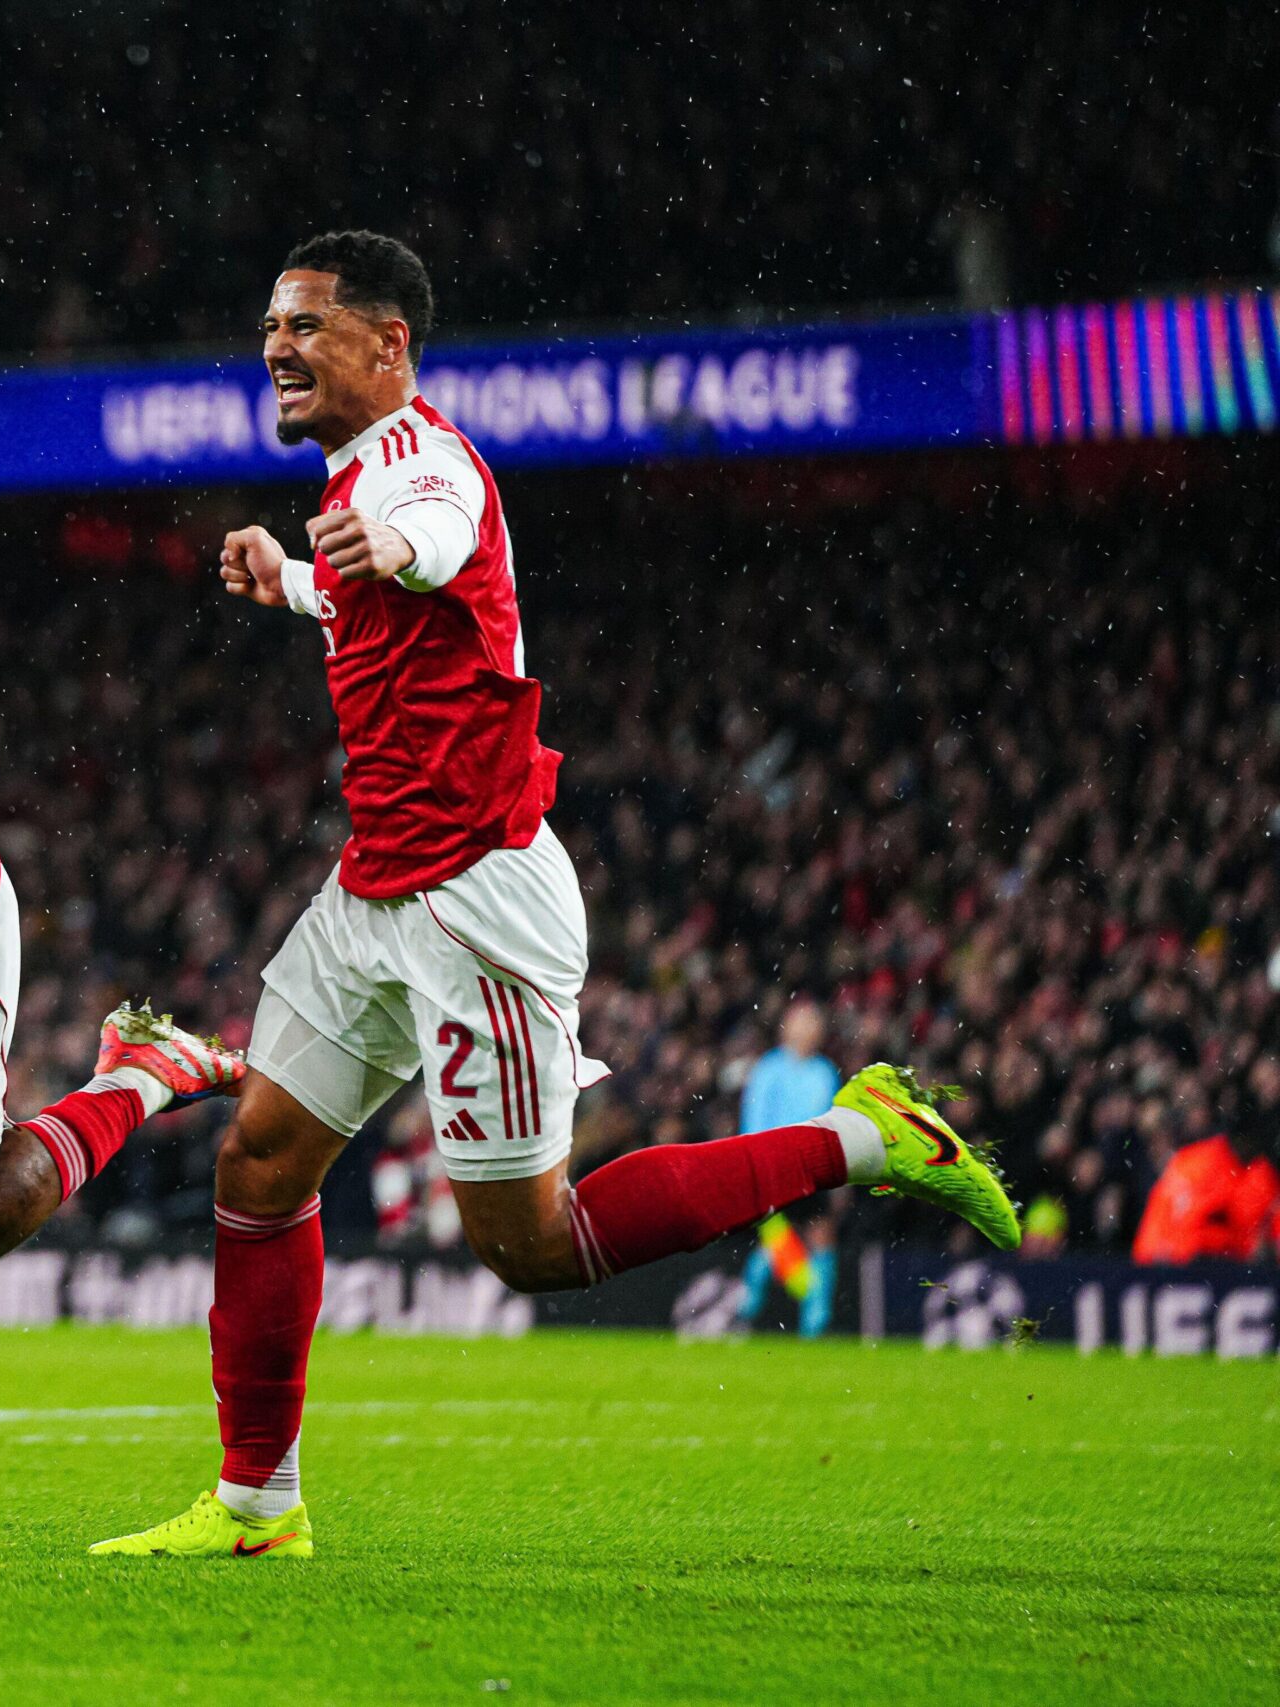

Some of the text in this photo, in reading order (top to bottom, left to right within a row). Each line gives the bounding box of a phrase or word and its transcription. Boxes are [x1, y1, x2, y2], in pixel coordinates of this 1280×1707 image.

[618, 346, 860, 436] LEAGUE
[436, 1020, 478, 1099] 2
[1074, 1282, 1280, 1358] UEF
